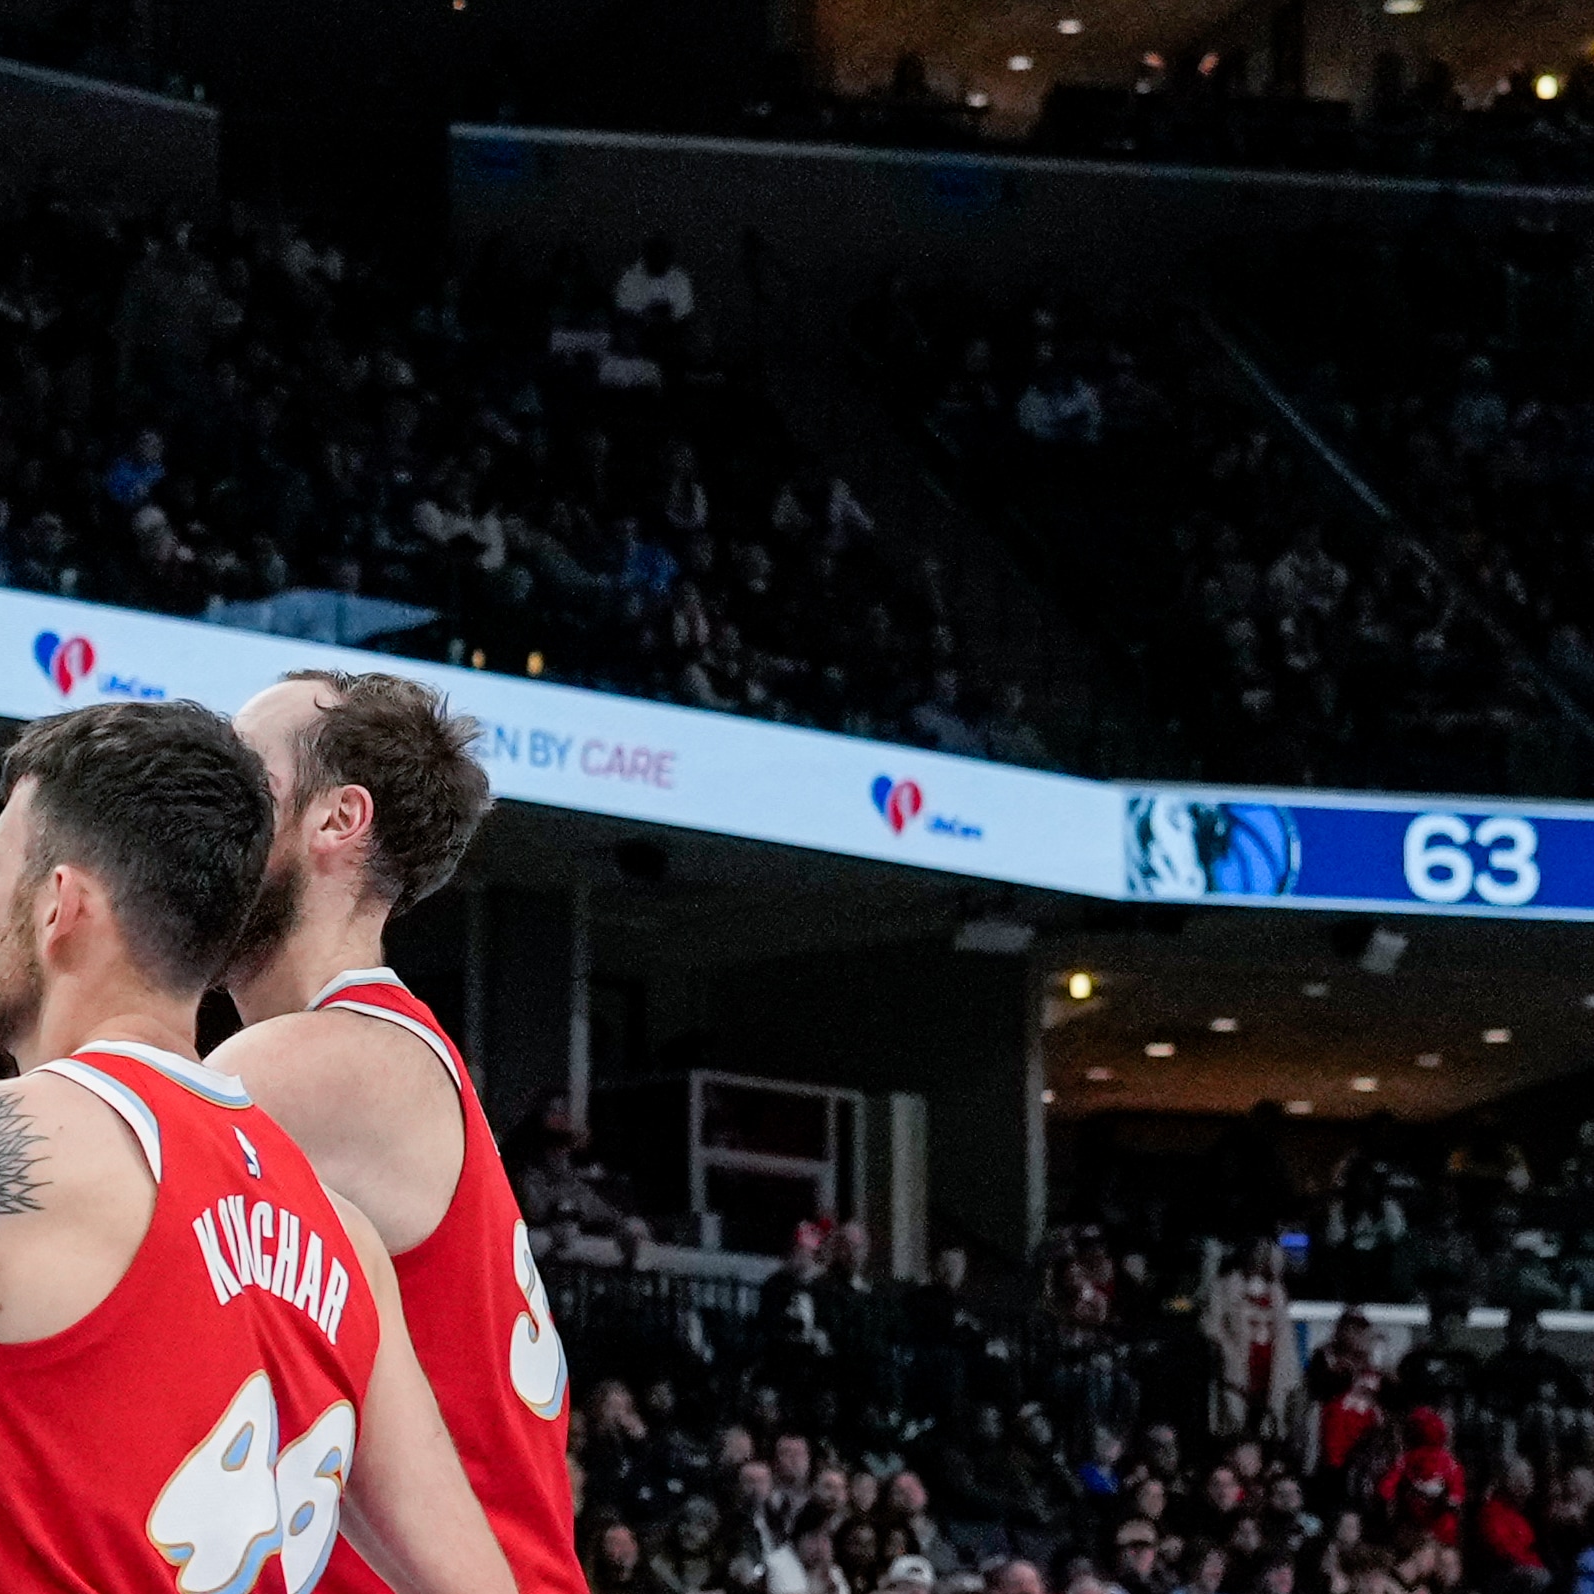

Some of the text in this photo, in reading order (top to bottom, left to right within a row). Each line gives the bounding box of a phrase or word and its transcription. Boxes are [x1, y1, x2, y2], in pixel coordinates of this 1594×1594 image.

[528, 727, 574, 770] BY
[579, 738, 676, 790] CARE
[1404, 812, 1540, 906] 63
